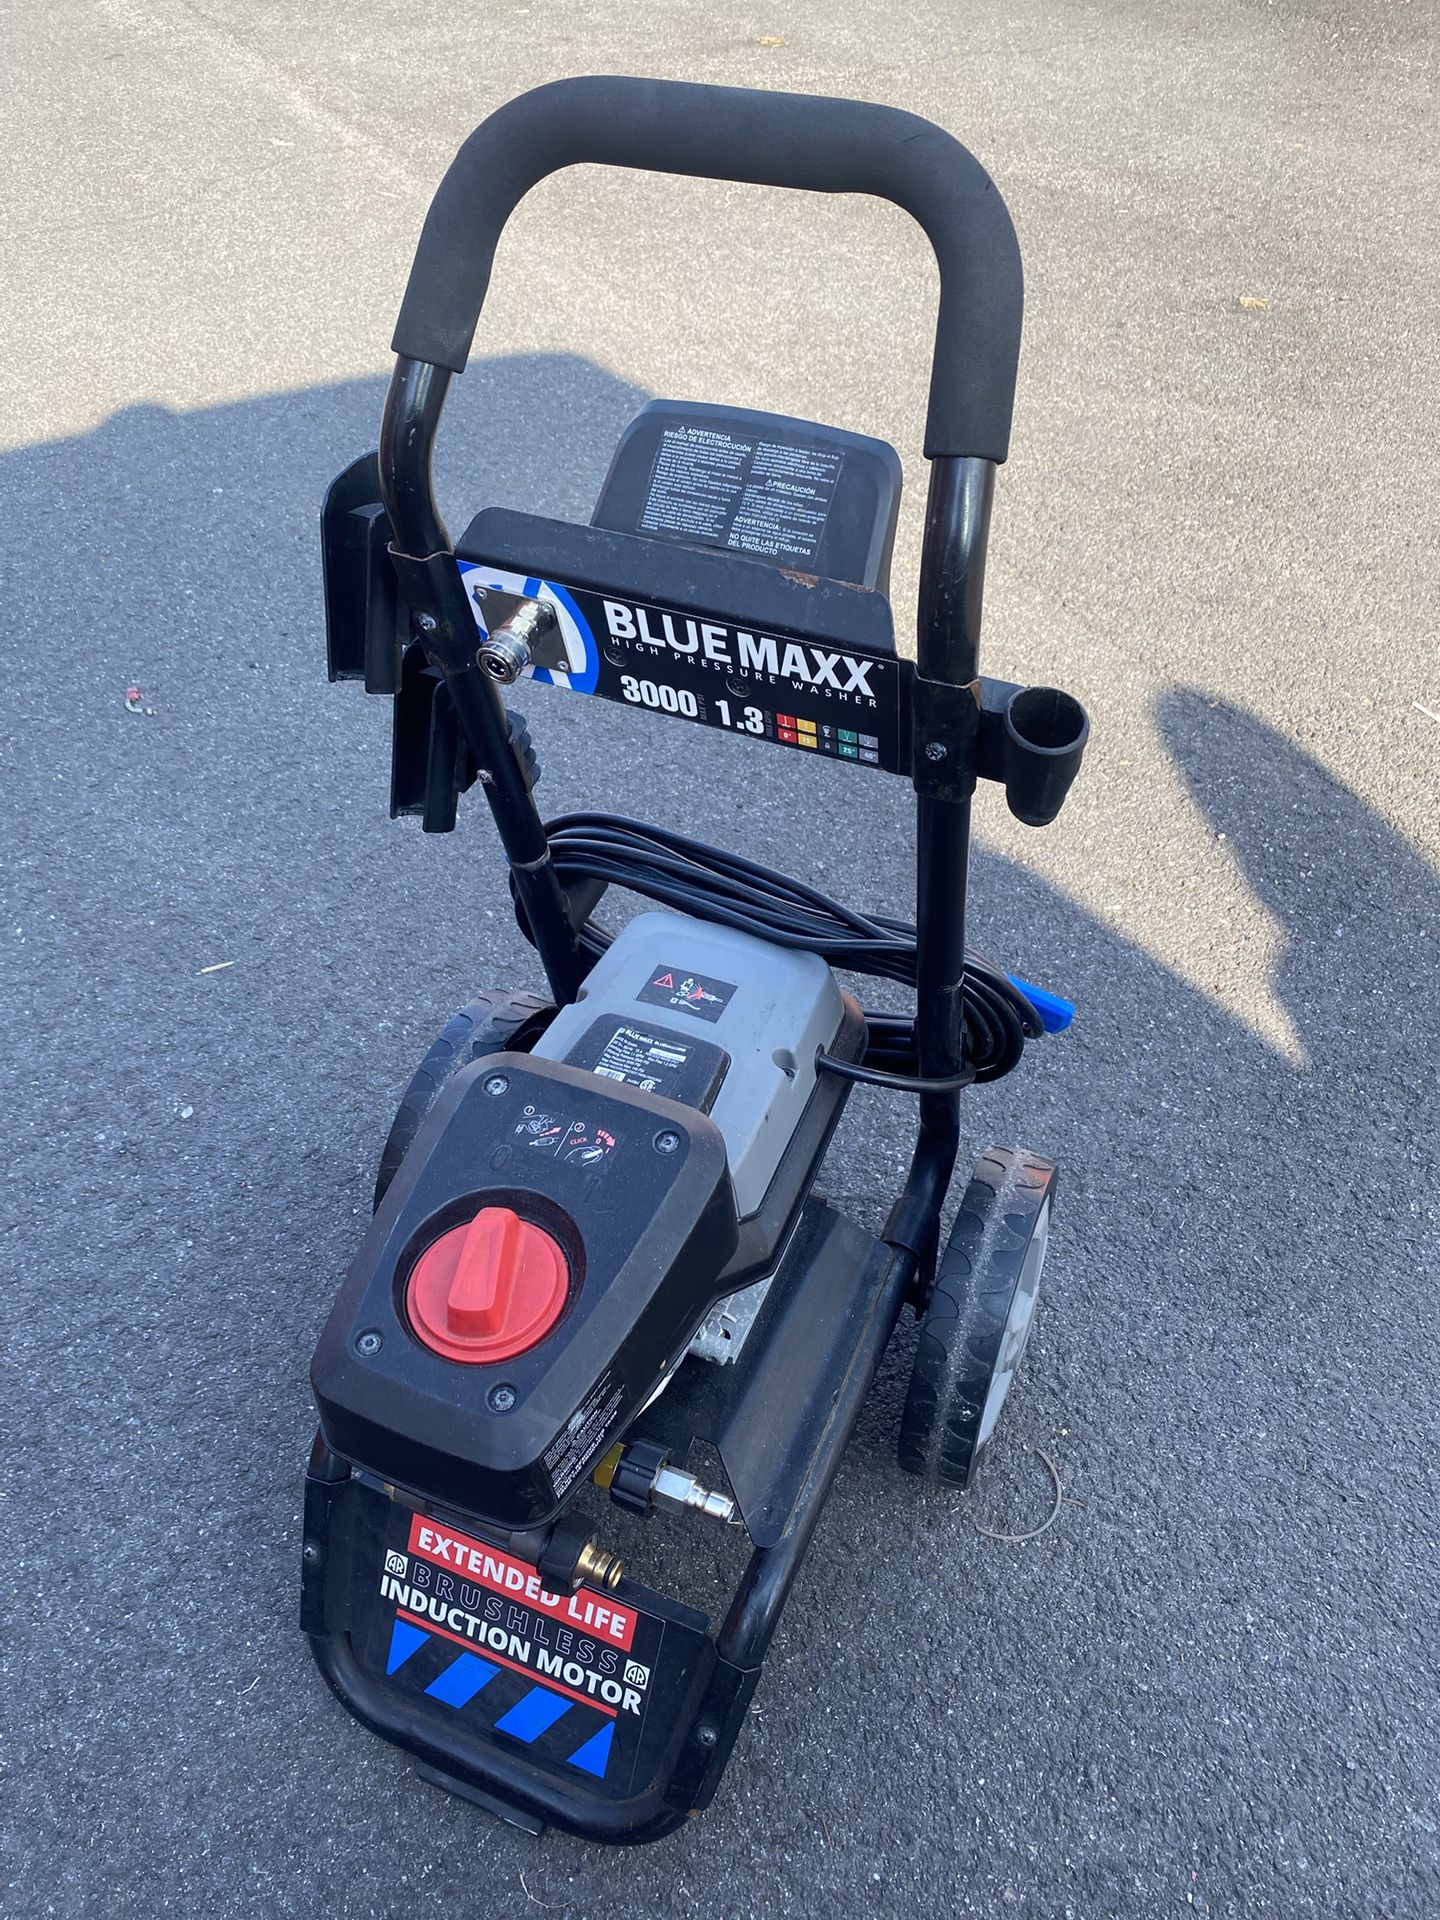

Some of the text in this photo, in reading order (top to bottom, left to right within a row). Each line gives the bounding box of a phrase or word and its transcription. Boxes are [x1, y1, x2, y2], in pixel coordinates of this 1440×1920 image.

[663, 430, 687, 440] RIESGO
[697, 436, 751, 452] ELECTROCUCIÓN
[687, 428, 731, 441] ADVERTENCIA
[771, 480, 816, 495] PRECAUCIÓN
[733, 515, 782, 530] ADVERTENCIA:
[727, 538, 778, 555] DEL PRODUCTO
[740, 534, 759, 544] QUITE
[760, 538, 774, 547] LAS
[774, 542, 811, 555] ETIQUETAS
[603, 601, 875, 697] BLUE MAXX
[612, 638, 877, 708] HIGH PRESSURE WASHER
[620, 675, 698, 717] 3000
[715, 699, 764, 734] 1.3
[570, 1137, 588, 1145] CLICK
[418, 1527, 626, 1639] EXTENDED LIFE
[413, 1562, 619, 1674] BRUSHLESS
[380, 1576, 641, 1716] INDUCTION MOTOR
